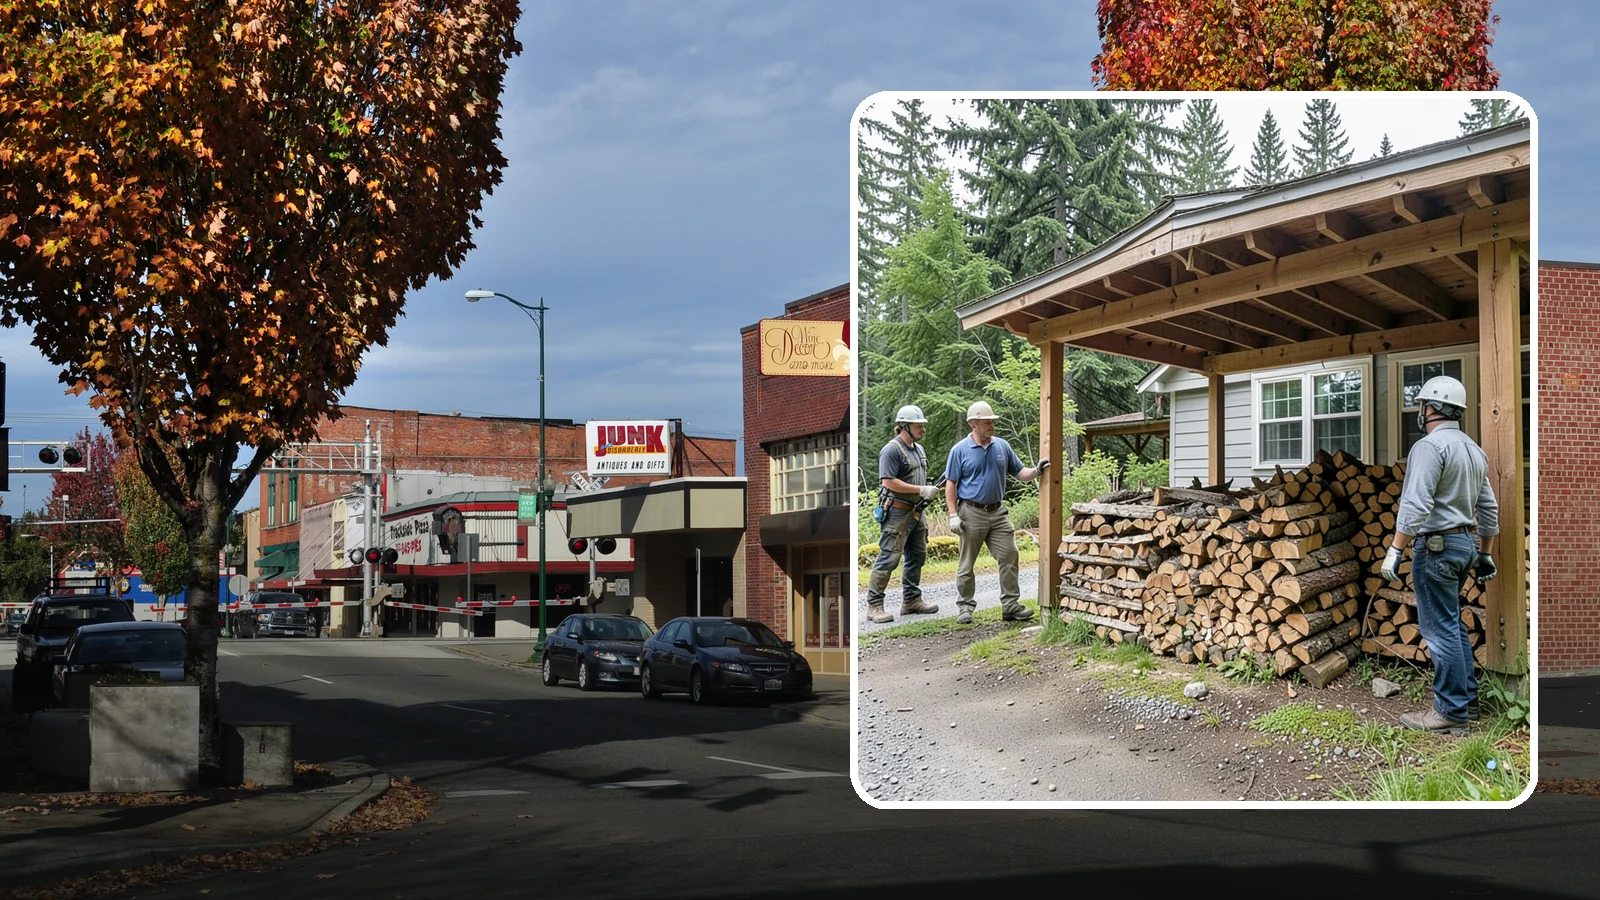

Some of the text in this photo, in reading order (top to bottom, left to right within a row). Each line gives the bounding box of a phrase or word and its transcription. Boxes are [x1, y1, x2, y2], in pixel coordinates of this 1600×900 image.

[765, 327, 831, 365] Decor
[595, 425, 665, 457] JUNK
[607, 446, 646, 454] DISORDERLY
[596, 460, 665, 470] ANTIQUES AND GIFTS
[390, 521, 413, 539] Trackside
[414, 519, 429, 534] Pizza
